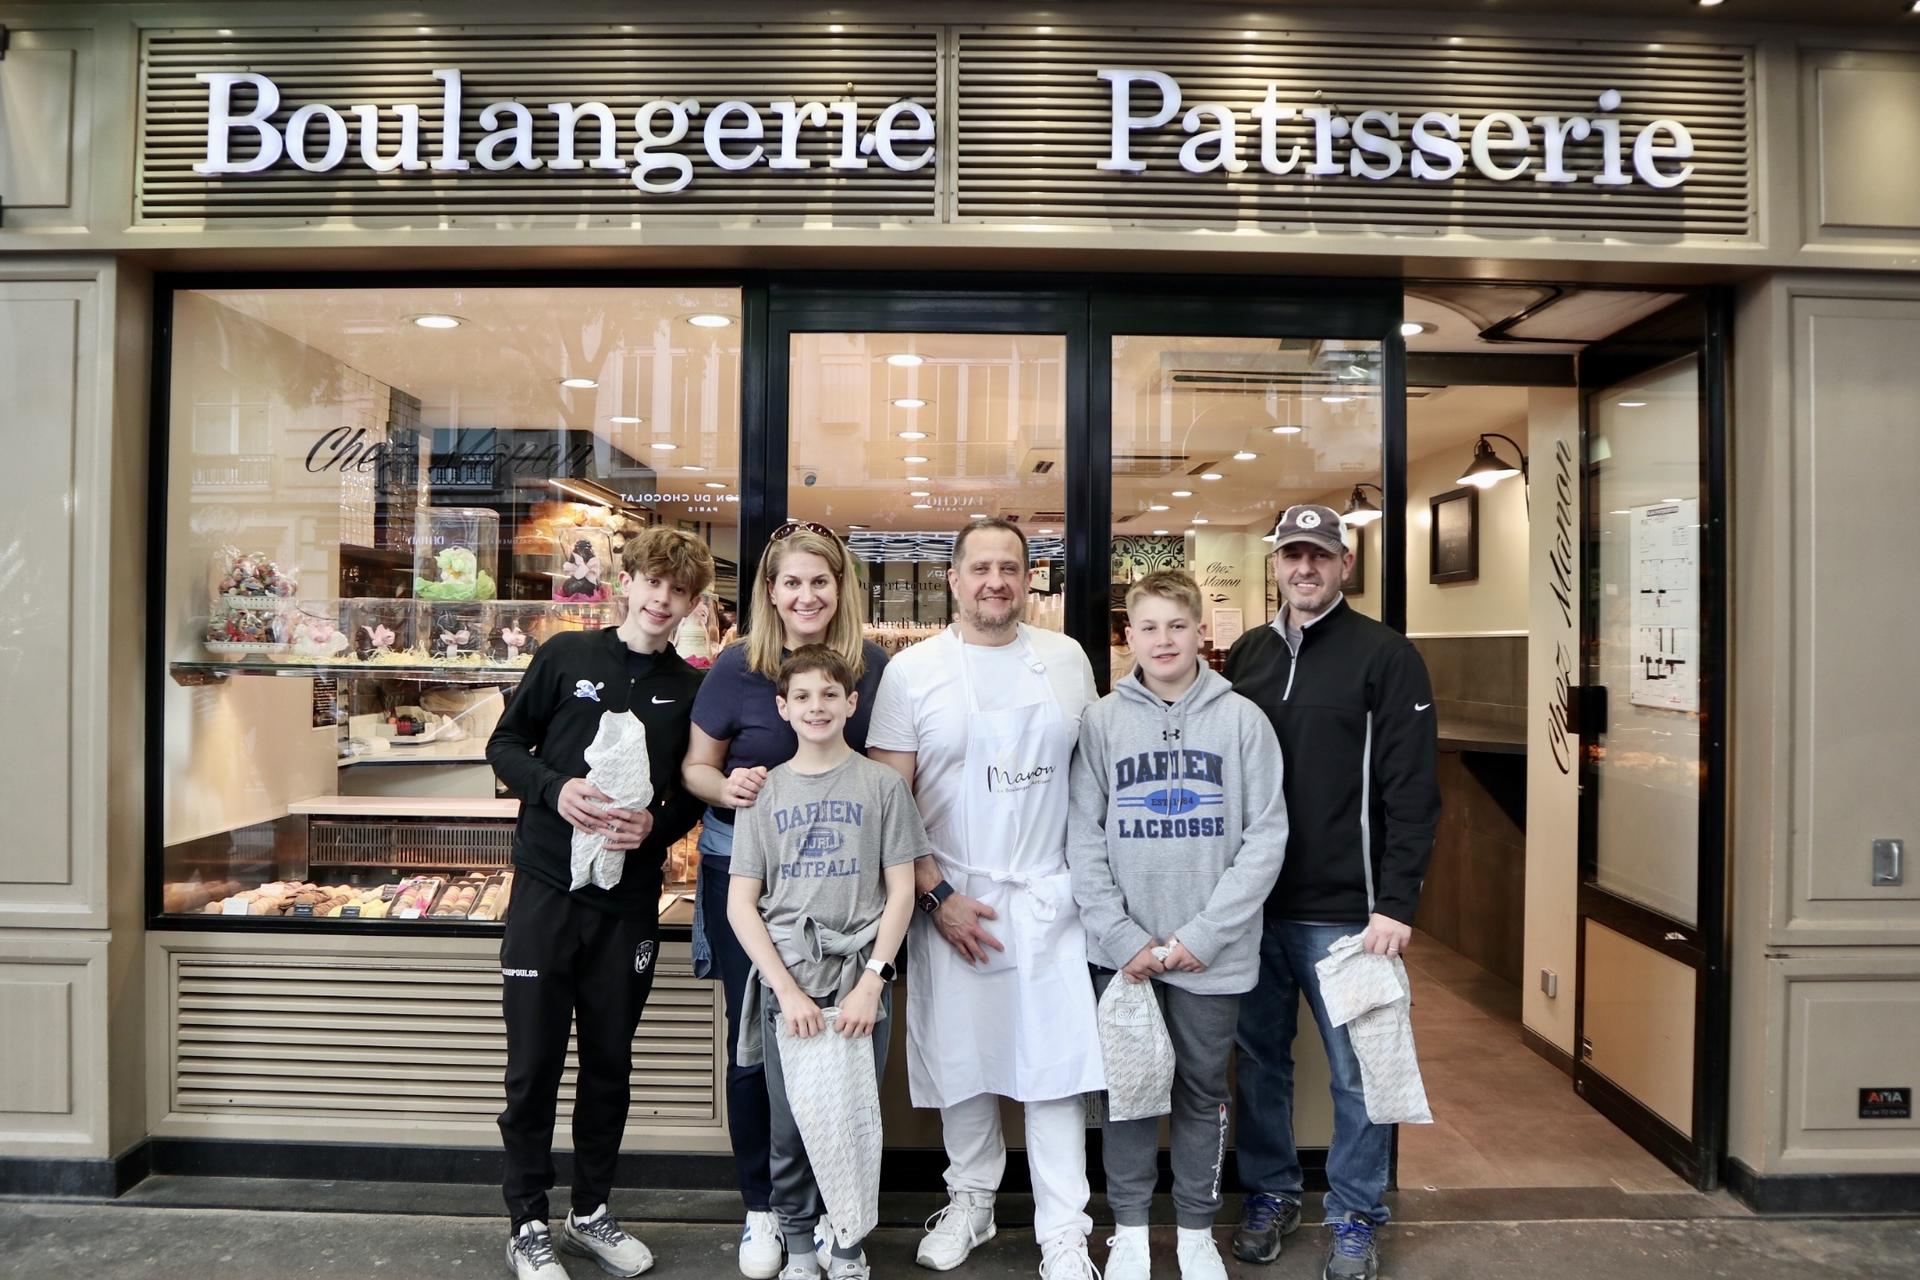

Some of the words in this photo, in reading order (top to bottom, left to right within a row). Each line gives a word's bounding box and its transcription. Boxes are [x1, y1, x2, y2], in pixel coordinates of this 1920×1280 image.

[193, 68, 936, 193] Boulangerie
[1096, 69, 1695, 188] Patisserie
[1549, 439, 1573, 629] Manon
[1200, 575, 1242, 588] Manon
[875, 635, 892, 648] de
[1548, 640, 1572, 775] Chez
[986, 765, 1057, 793] Manon
[1115, 749, 1224, 793] DARIEN
[774, 799, 863, 835] DARIEN
[1118, 816, 1225, 839] LACROSSE
[780, 857, 861, 880] FOTBALL
